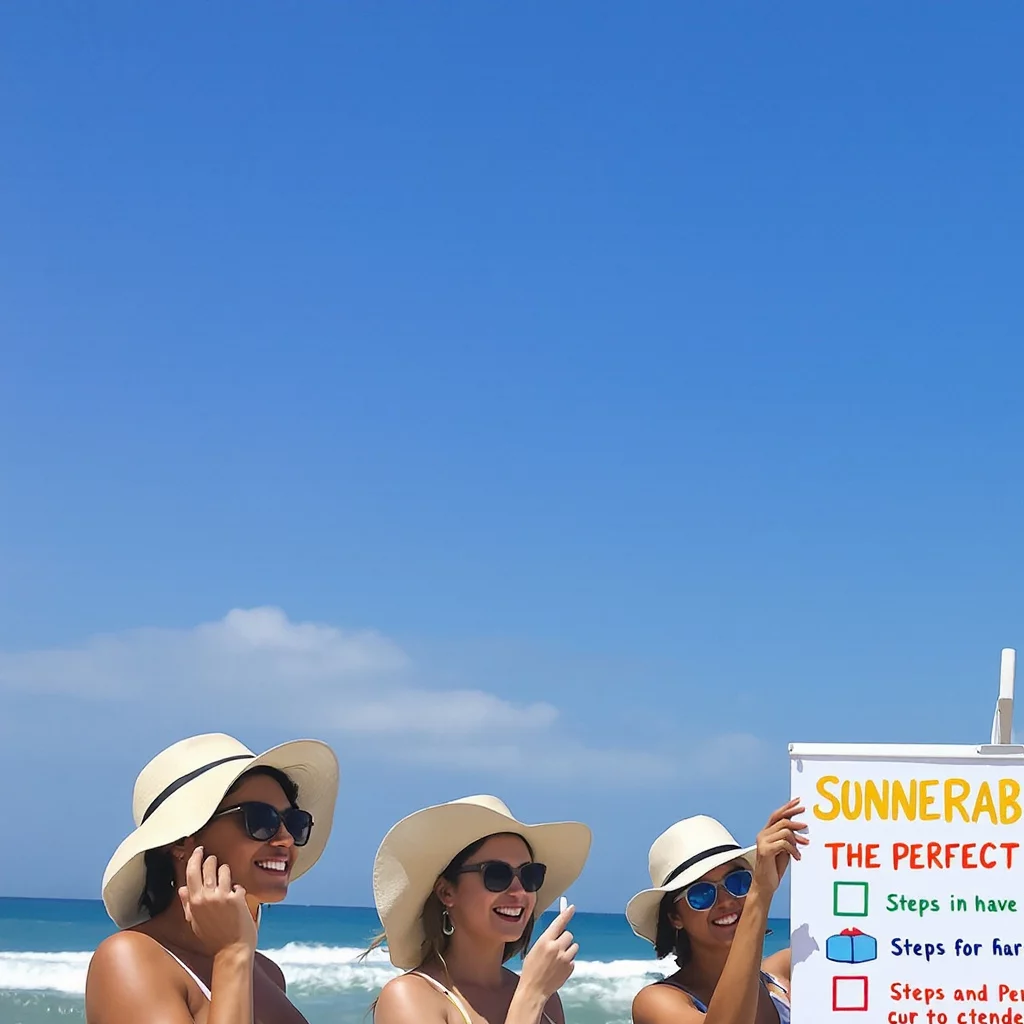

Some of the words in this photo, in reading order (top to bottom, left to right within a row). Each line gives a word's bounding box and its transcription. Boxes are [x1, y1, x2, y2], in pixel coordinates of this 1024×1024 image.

[813, 775, 1022, 825] SUNNERAB
[824, 842, 881, 870] THE
[893, 842, 1020, 870] PERFECT
[886, 894, 940, 917] Steps
[951, 895, 967, 912] in
[975, 895, 1017, 912] have
[891, 938, 945, 962] Steps
[955, 938, 982, 956] for
[890, 983, 945, 1005] Steps
[954, 984, 988, 1002] and
[888, 1011, 918, 1024] cur
[926, 1009, 948, 1024] to
